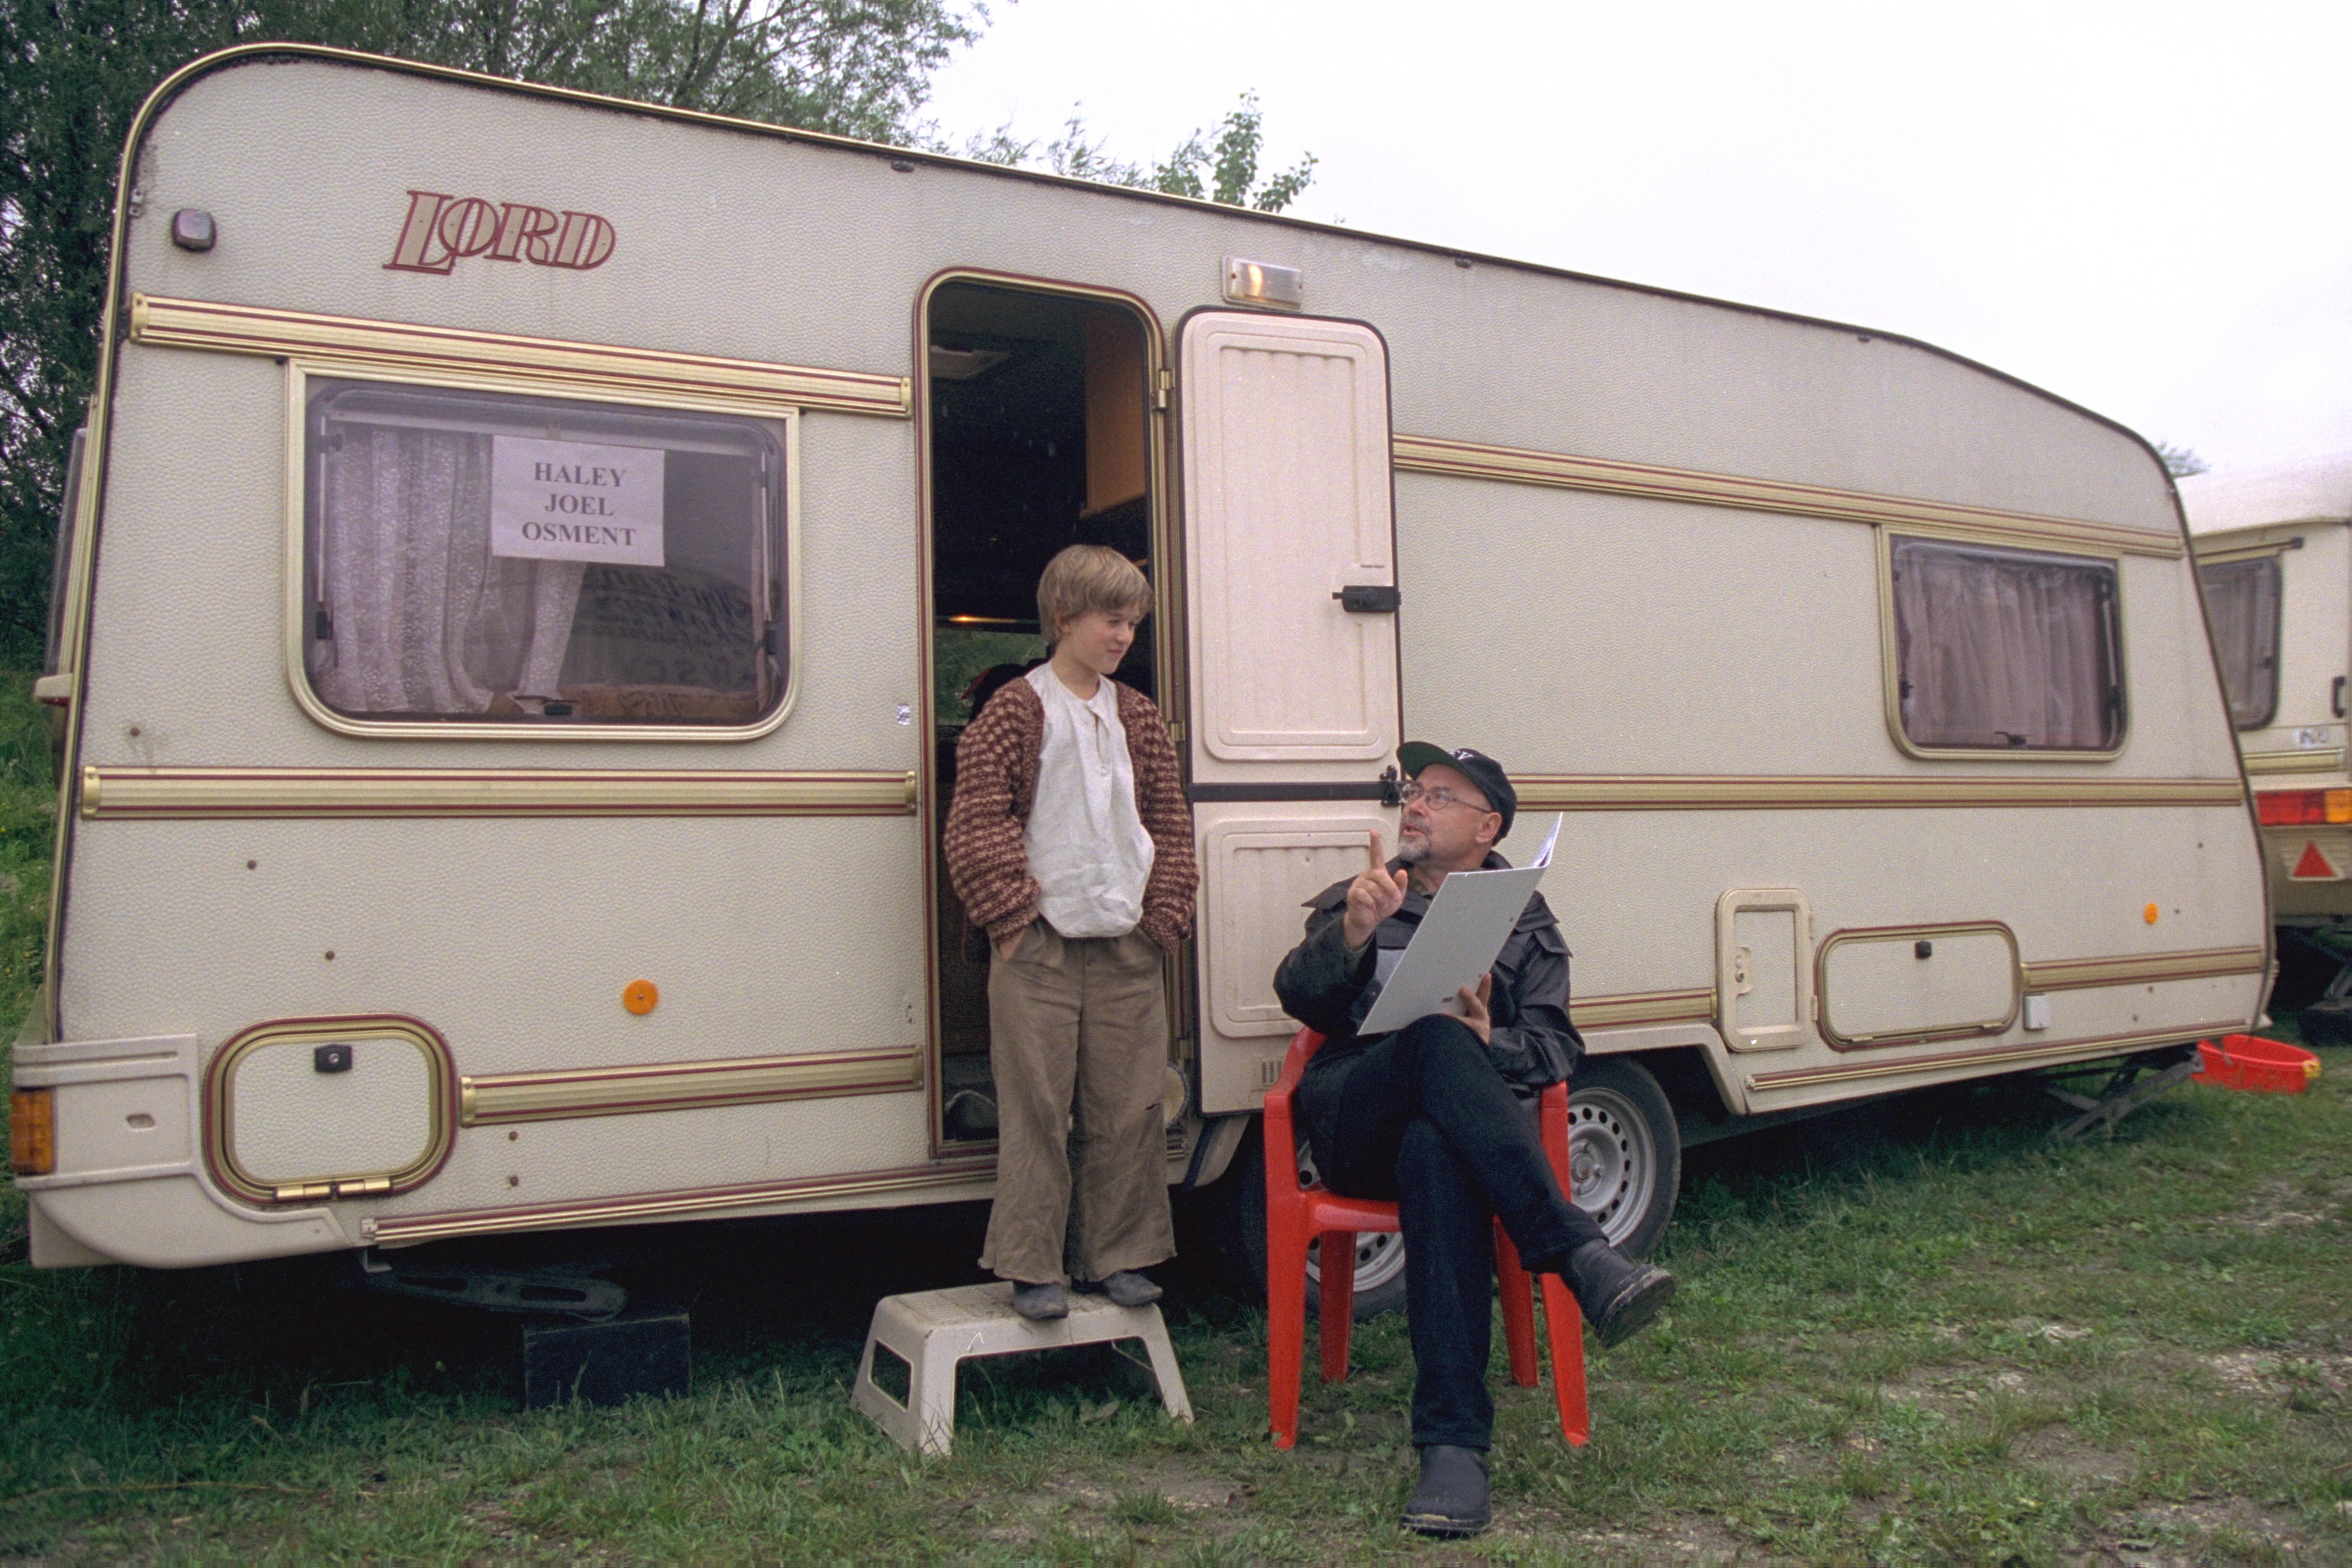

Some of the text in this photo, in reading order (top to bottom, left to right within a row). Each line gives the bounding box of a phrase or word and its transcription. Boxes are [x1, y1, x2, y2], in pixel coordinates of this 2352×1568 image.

[382, 190, 616, 276] LORD
[534, 462, 626, 488] HALEY
[544, 493, 614, 516] JOEL
[521, 521, 637, 546] OSMENT
